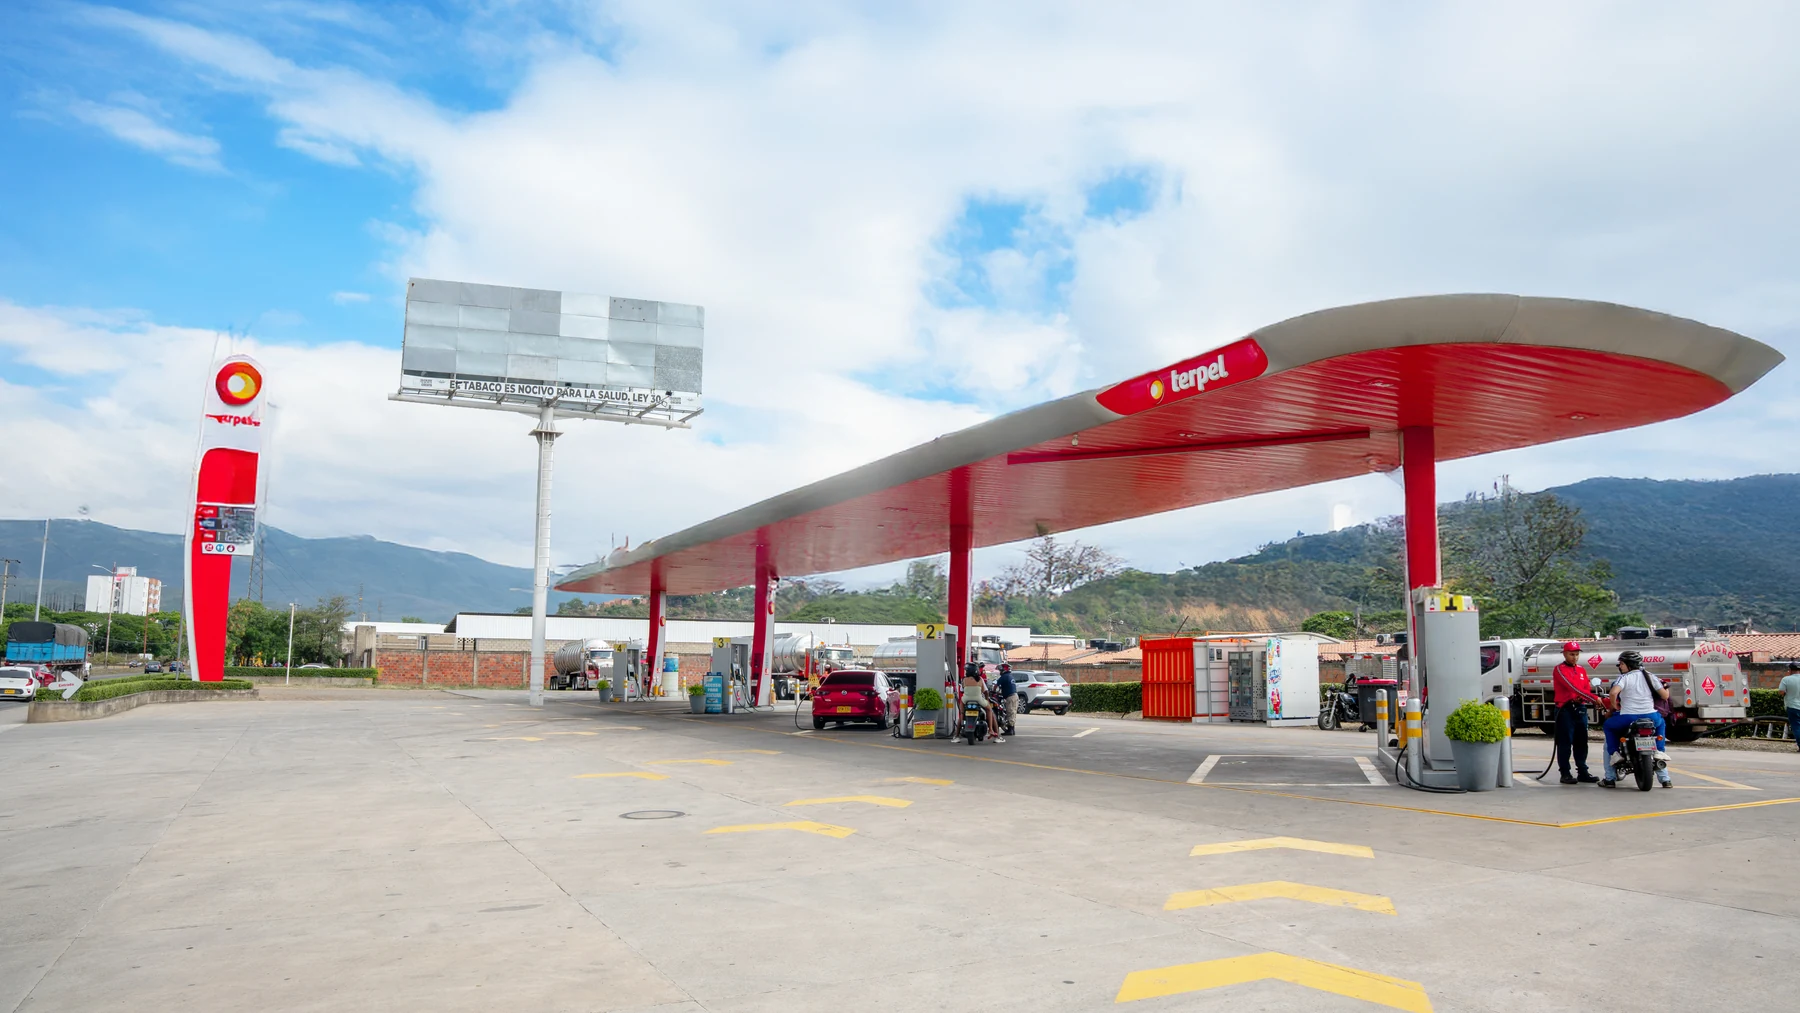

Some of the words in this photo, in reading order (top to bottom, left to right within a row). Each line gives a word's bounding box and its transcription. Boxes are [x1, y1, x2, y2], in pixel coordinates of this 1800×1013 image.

[1171, 354, 1228, 392] terpel
[464, 381, 502, 392] TABACO
[504, 383, 516, 394] ES
[518, 385, 555, 396] NOCIVO
[556, 387, 582, 398] PARA
[584, 390, 596, 399] LA
[632, 393, 649, 403] LEY
[1445, 594, 1458, 611] 1
[926, 624, 935, 639] 2
[616, 644, 622, 652] 4
[718, 637, 725, 648] 3
[1642, 655, 1666, 663] IGRO
[1697, 644, 1733, 659] PELIGRO
